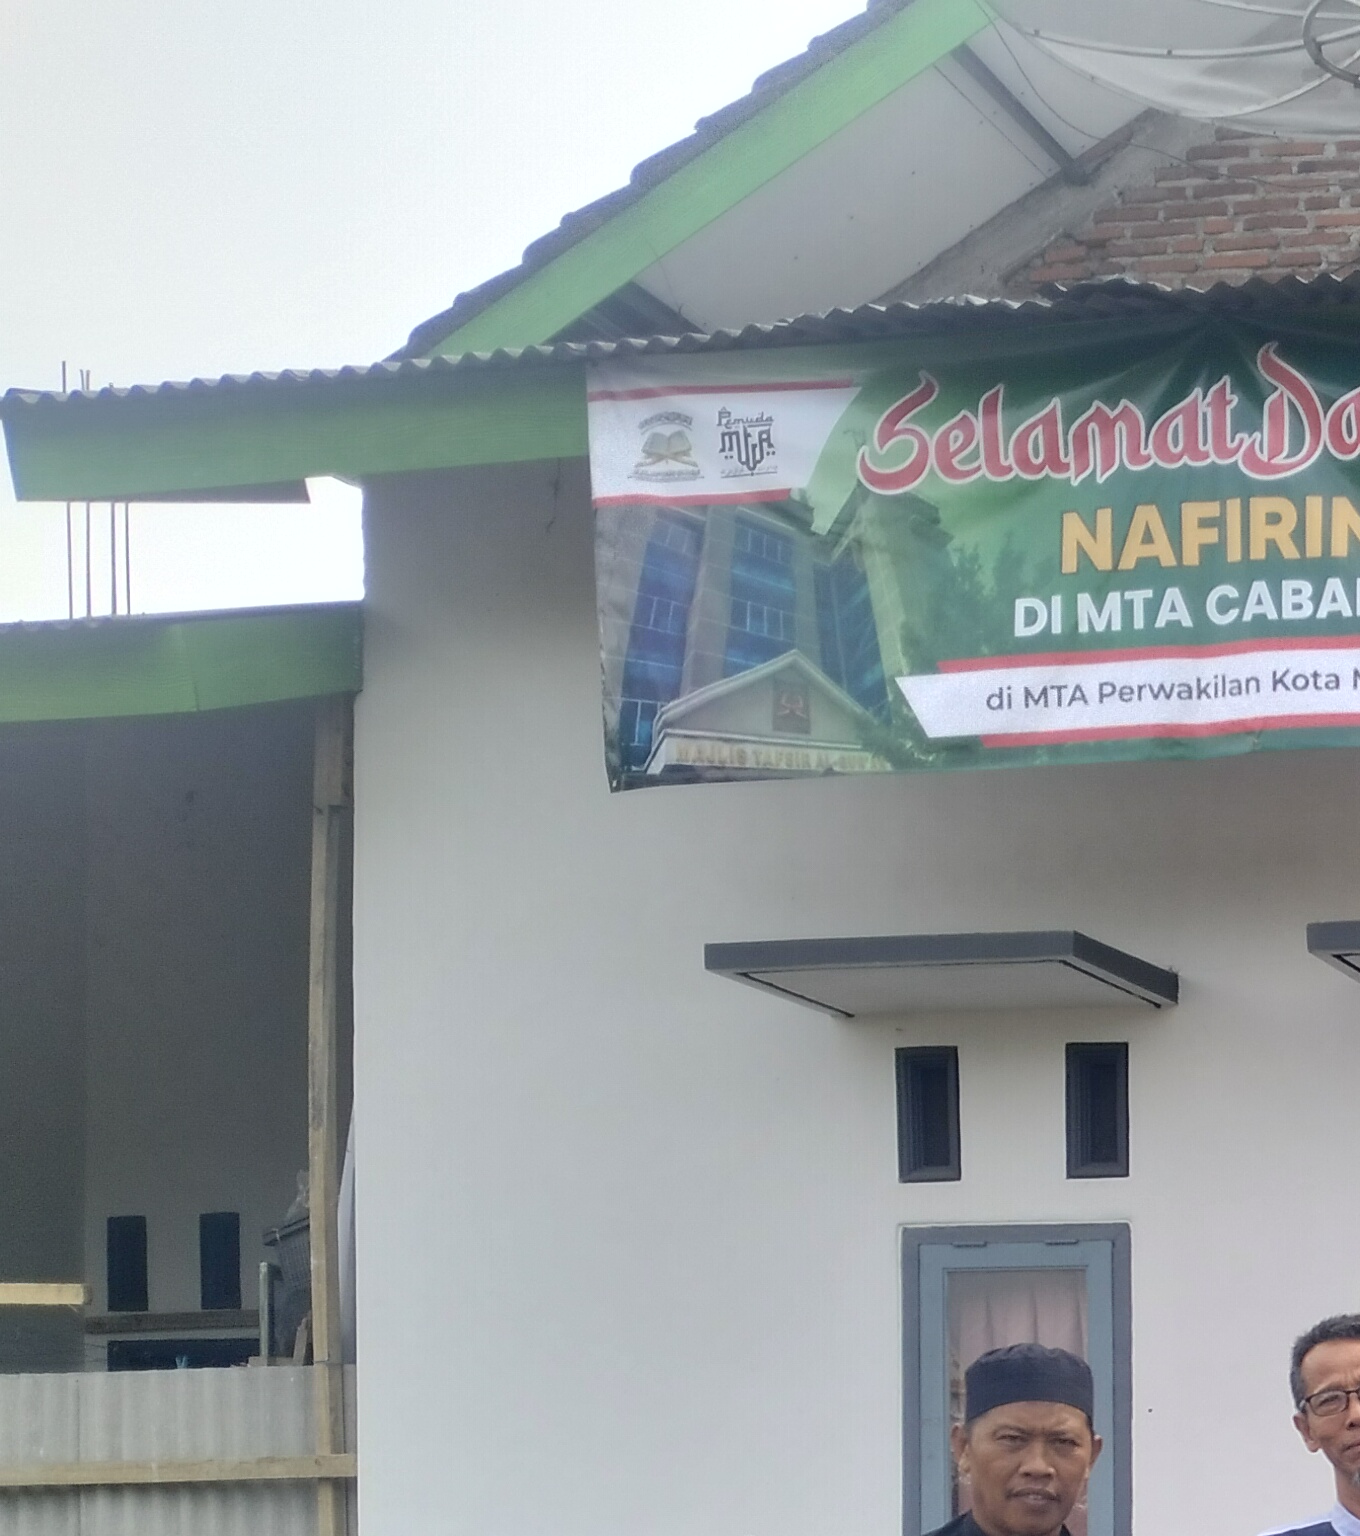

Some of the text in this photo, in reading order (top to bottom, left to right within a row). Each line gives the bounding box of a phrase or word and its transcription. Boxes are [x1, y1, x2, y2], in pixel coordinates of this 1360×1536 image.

[858, 370, 1246, 494] Selamat
[1013, 595, 1061, 637] DI
[1077, 586, 1194, 633] MTA
[985, 681, 1014, 712] di
[1023, 680, 1089, 710] MTA
[1098, 670, 1260, 706] Perwakilan
[1271, 665, 1342, 694] Kota
